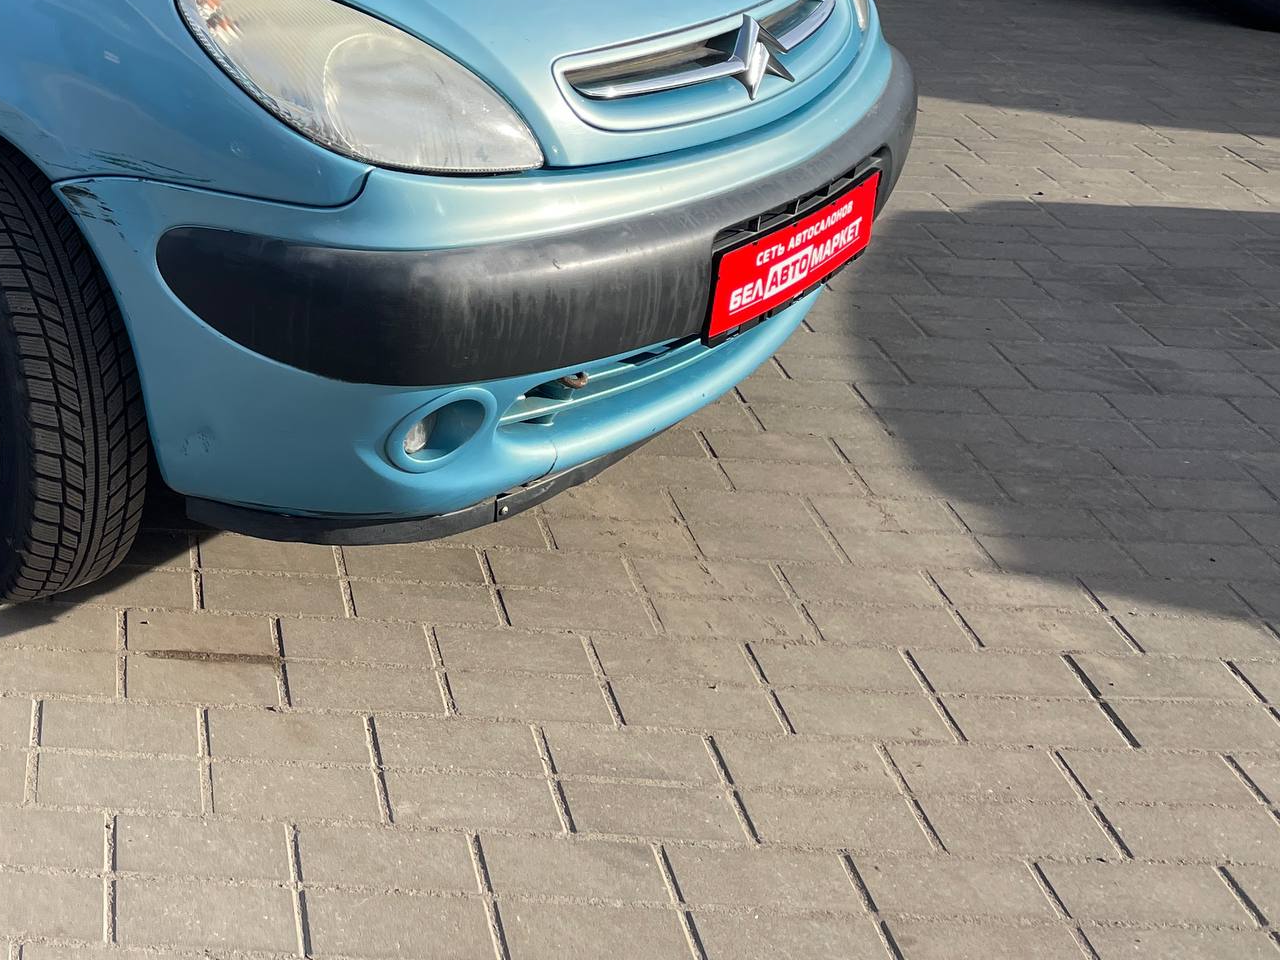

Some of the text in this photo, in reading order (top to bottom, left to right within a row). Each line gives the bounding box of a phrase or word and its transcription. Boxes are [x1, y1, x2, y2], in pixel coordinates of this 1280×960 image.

[728, 216, 863, 312] БЕЛАВТОМАРКЕТ
[755, 200, 854, 267] СЕТЬ АВТОСАЛОНОВ
